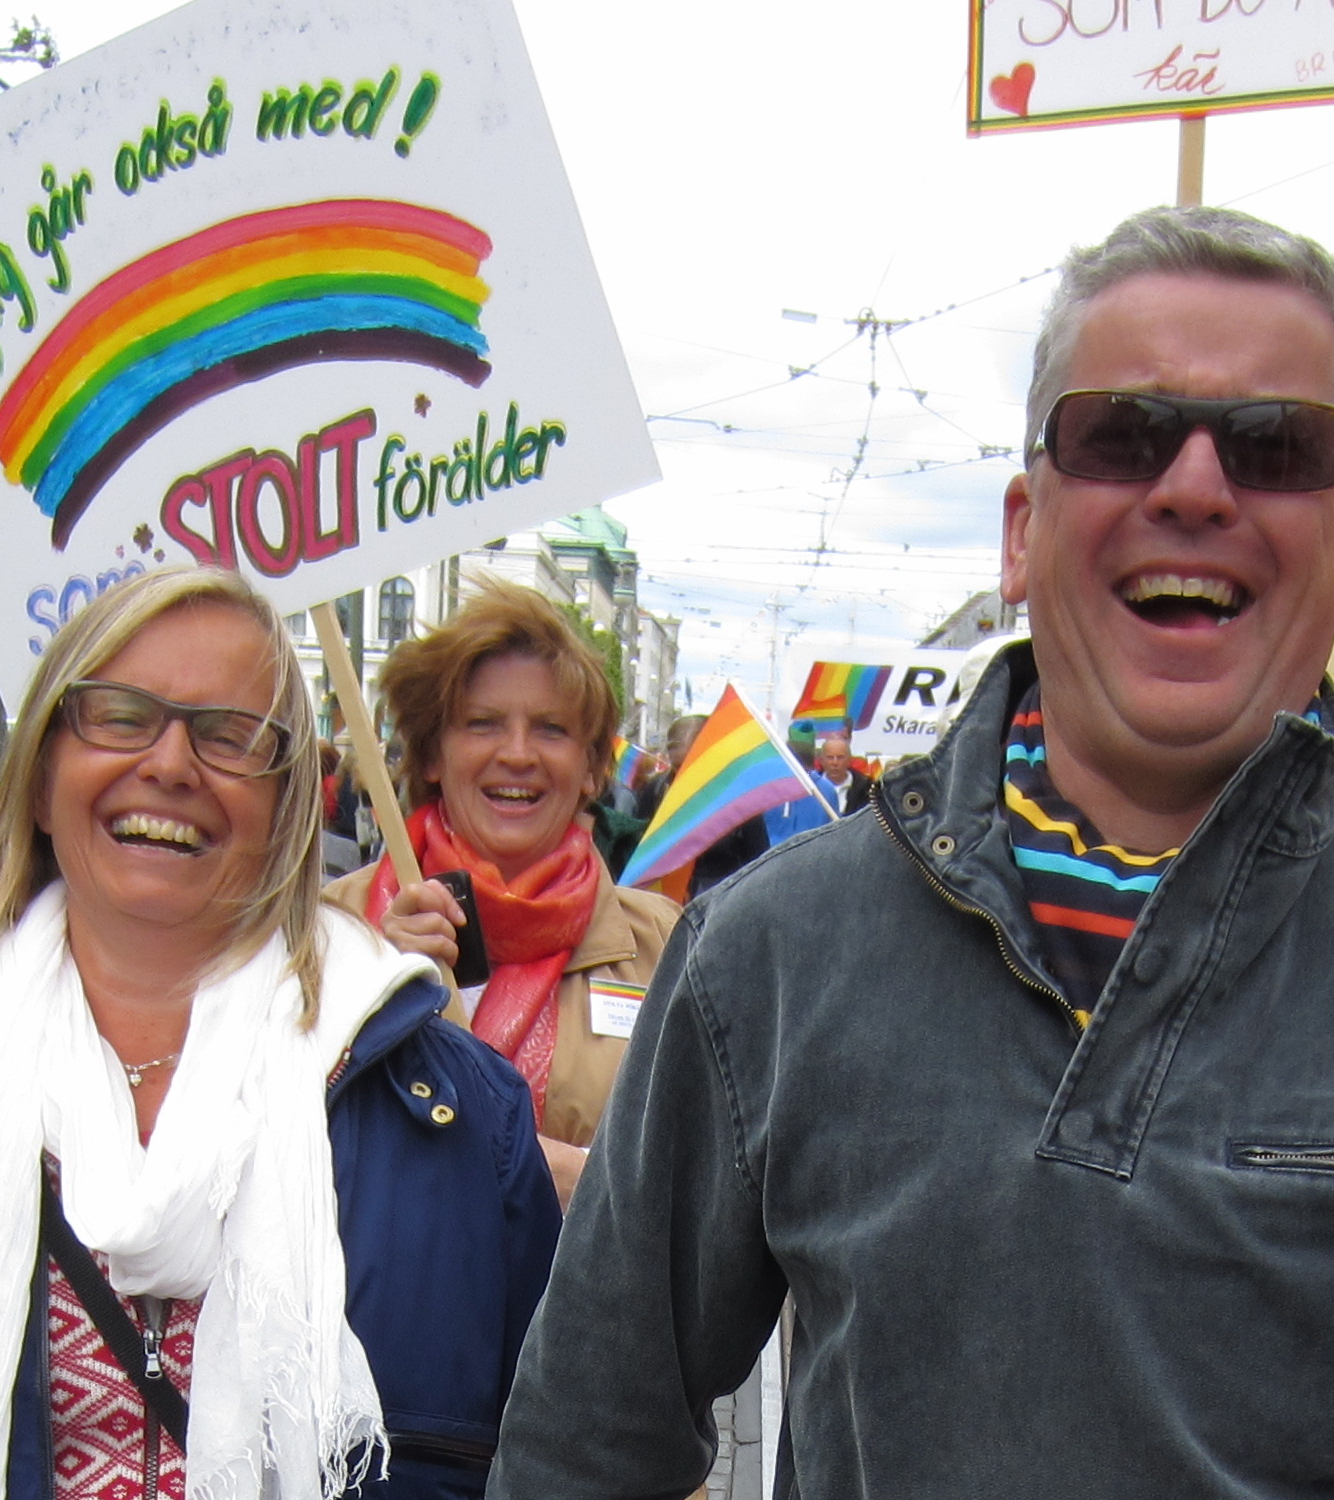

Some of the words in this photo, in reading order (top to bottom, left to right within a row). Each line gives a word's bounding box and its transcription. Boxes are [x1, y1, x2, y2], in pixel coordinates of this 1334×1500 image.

[27, 165, 92, 293] går
[114, 78, 233, 196] också
[161, 408, 376, 578] STOLT
[373, 402, 566, 531] förälder
